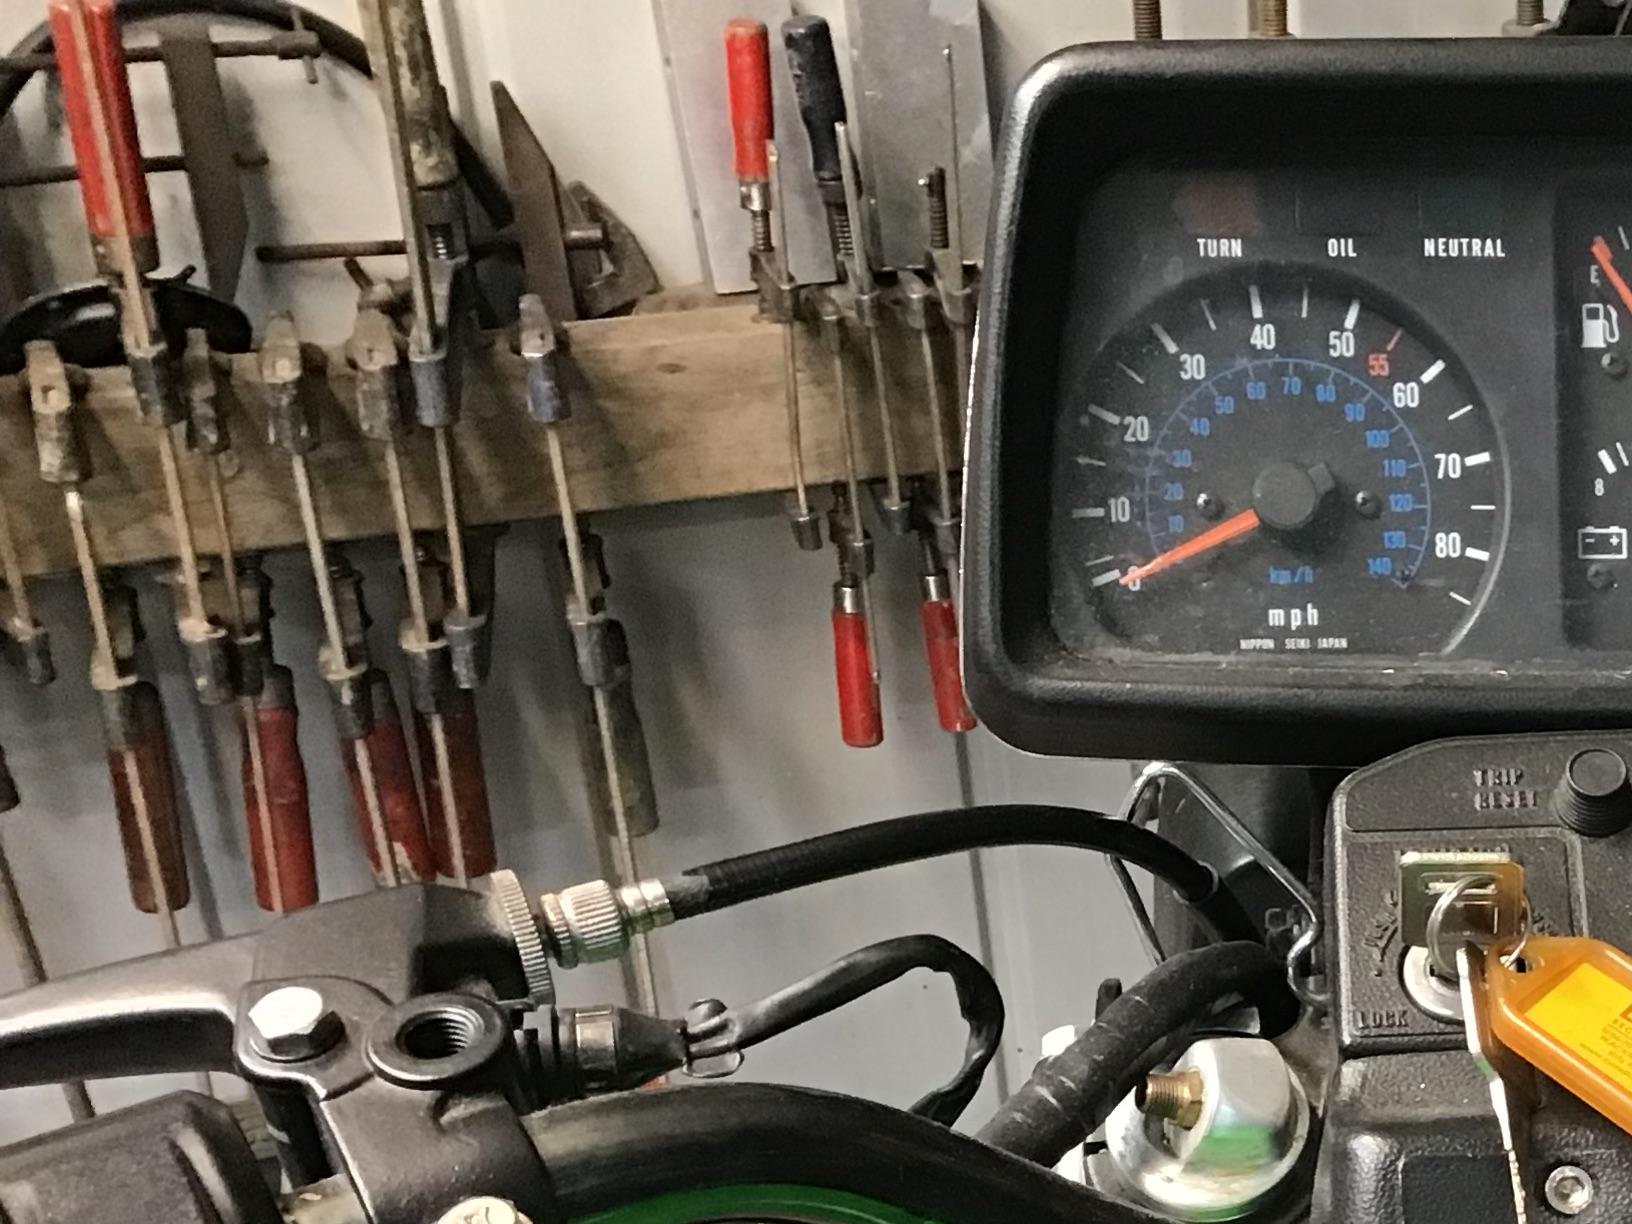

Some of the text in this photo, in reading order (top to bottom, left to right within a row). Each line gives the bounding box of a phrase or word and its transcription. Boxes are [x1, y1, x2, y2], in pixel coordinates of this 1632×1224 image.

[1197, 238, 1242, 257] TURN
[1327, 238, 1357, 257] OIL
[1424, 238, 1505, 257] NEUTRAL
[1590, 264, 1600, 284] E
[1250, 324, 1275, 350] 40
[1329, 331, 1355, 357] 50
[1180, 354, 1205, 380] 30
[1368, 353, 1389, 376] 55
[1281, 377, 1301, 395] 70
[1393, 382, 1419, 408] 60
[1214, 396, 1234, 414] 50
[1344, 403, 1365, 422] 90
[1124, 416, 1149, 441] 20
[1190, 418, 1210, 436] 40
[1365, 430, 1390, 448] 100
[1383, 459, 1406, 477] 110
[1434, 453, 1461, 479] 70
[1594, 478, 1605, 496] 8
[1108, 496, 1130, 522] 10
[1390, 494, 1413, 512] 120
[1384, 531, 1406, 549] 130
[1435, 532, 1461, 558] 80
[1269, 565, 1314, 585] km/h
[1368, 557, 1392, 576] 140
[1473, 767, 1523, 787] TRIP
[1474, 790, 1537, 811] RESET
[1357, 1009, 1409, 1030] LOCK
